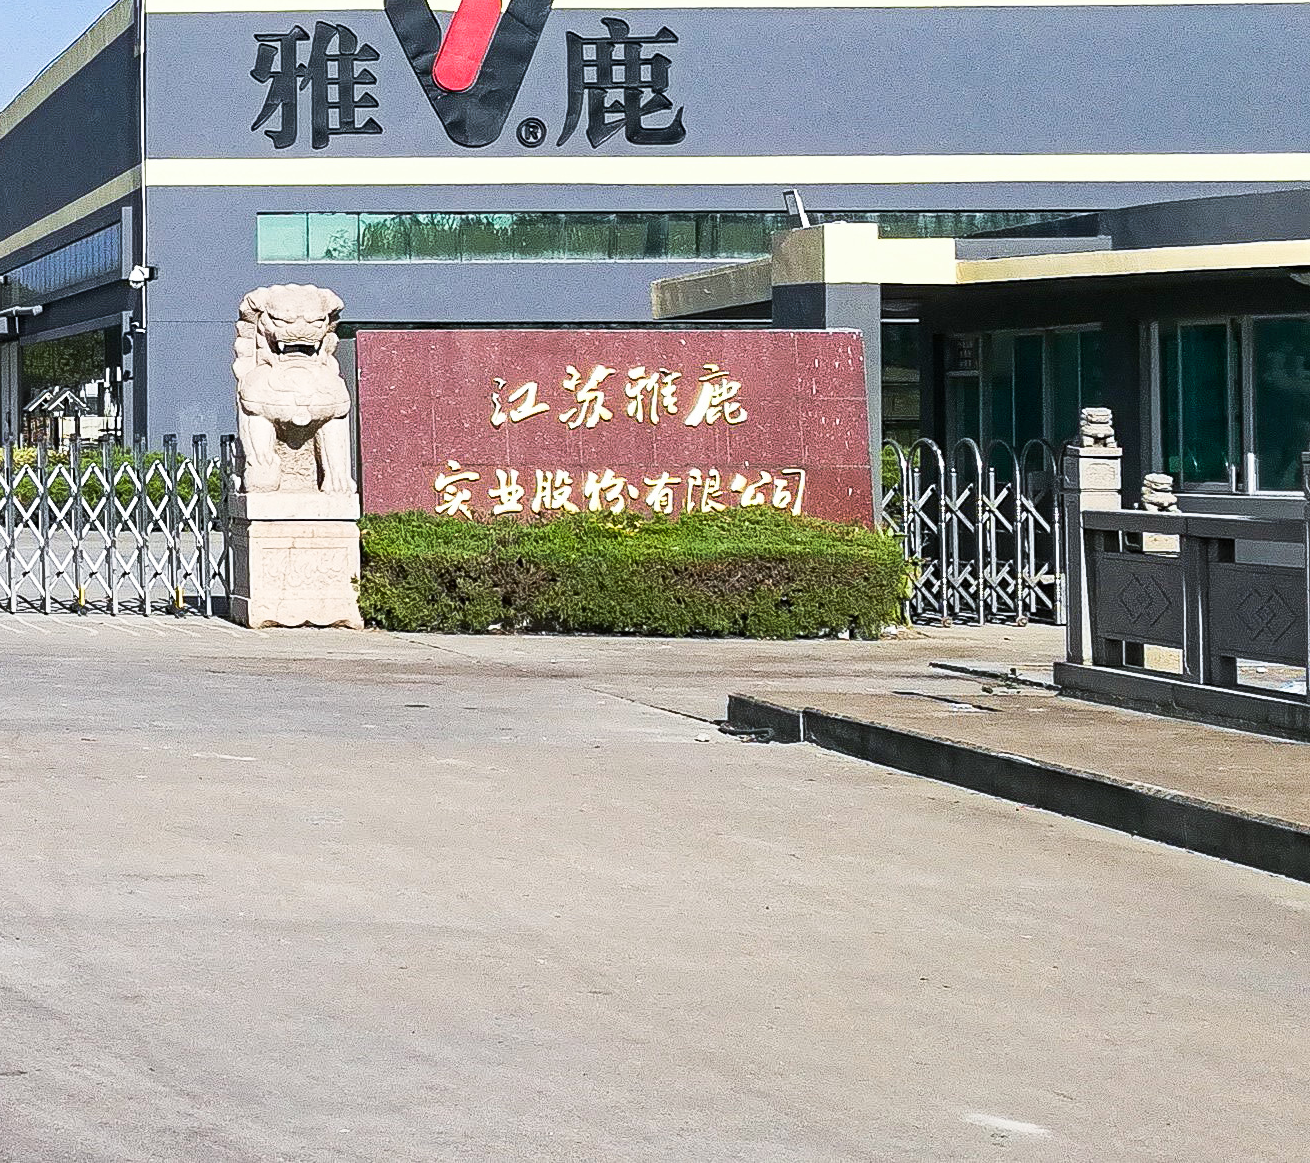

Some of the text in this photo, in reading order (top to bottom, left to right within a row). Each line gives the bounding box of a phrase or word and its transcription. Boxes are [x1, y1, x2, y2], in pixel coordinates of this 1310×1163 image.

[490, 363, 748, 430] 江苏雅鹿
[434, 460, 806, 518] 实业股份有限公司
